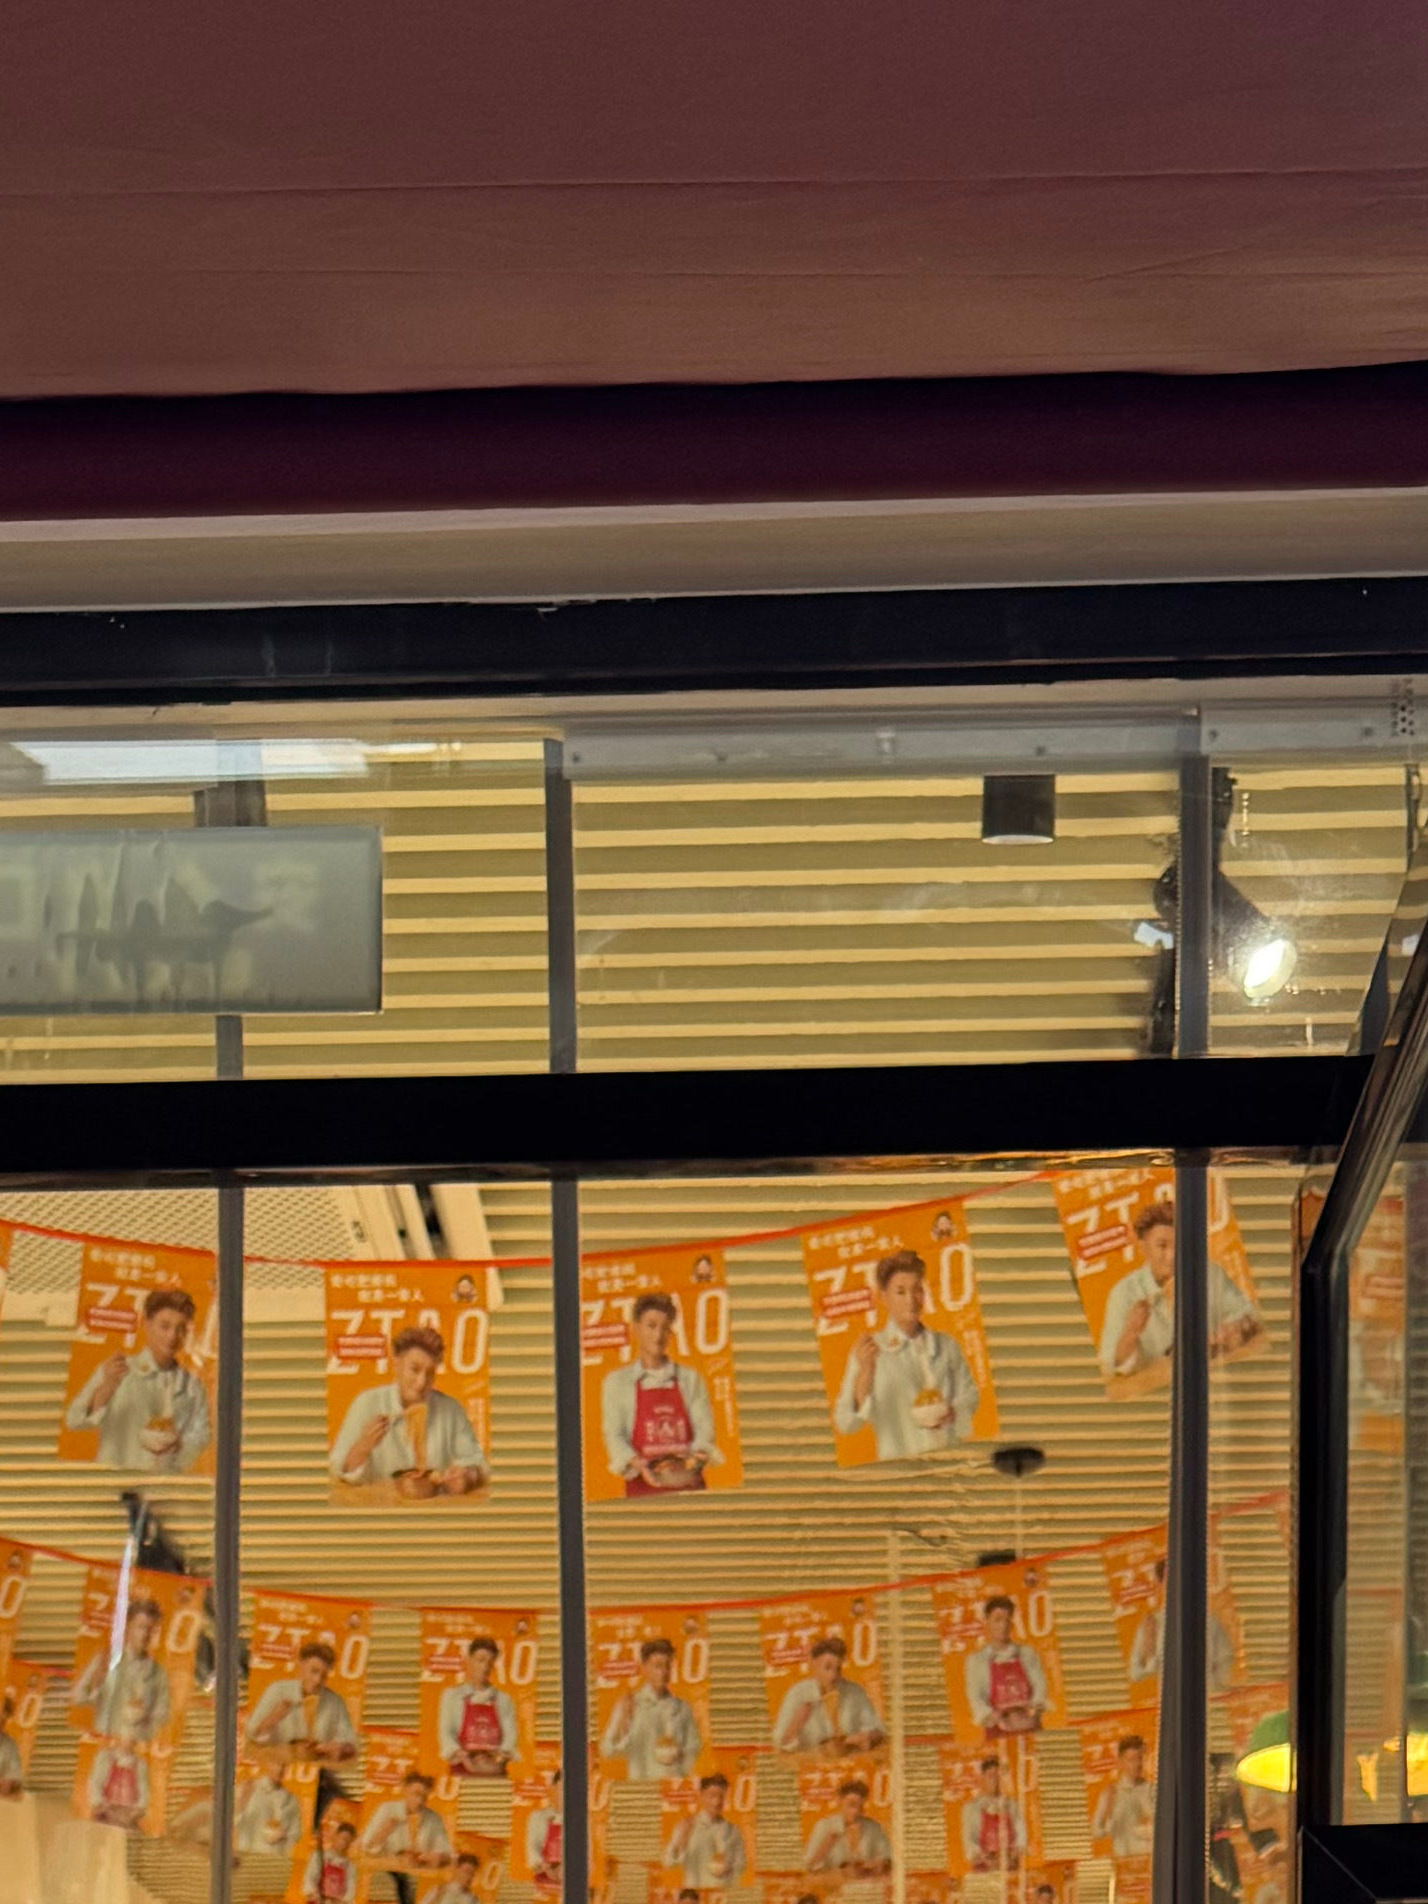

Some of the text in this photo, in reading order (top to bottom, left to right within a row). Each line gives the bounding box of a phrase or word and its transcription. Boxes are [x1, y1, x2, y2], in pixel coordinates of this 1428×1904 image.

[1065, 1176, 1230, 1278] ZT
[76, 1281, 220, 1367] ZT
[812, 1242, 974, 1337] ZTO
[76, 1591, 203, 1654] ZO
[594, 1637, 710, 1689] ZTO
[364, 1757, 461, 1801] ZTO
